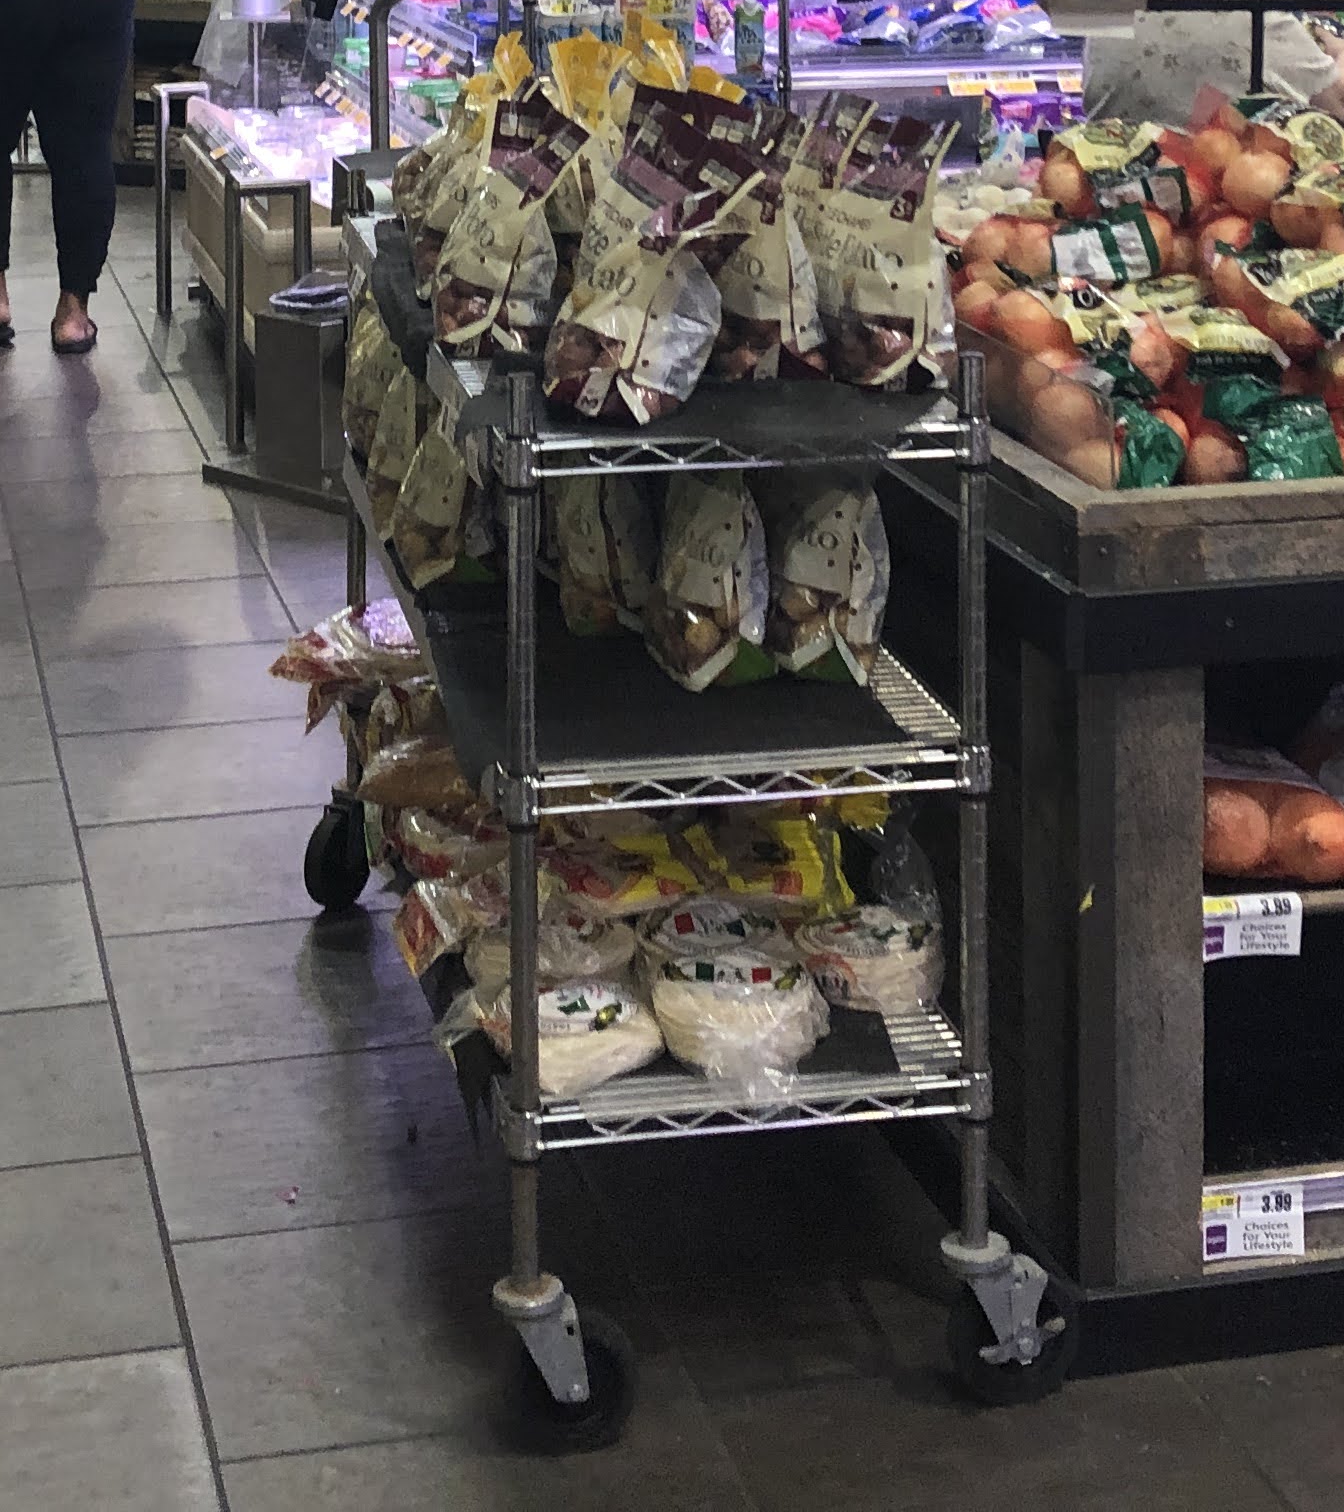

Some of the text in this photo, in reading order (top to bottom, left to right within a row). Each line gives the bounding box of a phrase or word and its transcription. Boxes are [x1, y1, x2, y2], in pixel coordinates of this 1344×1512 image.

[1244, 1221, 1289, 1231] Choices
[1243, 1232, 1259, 1241] for
[1243, 1241, 1293, 1252] Lifestyle
